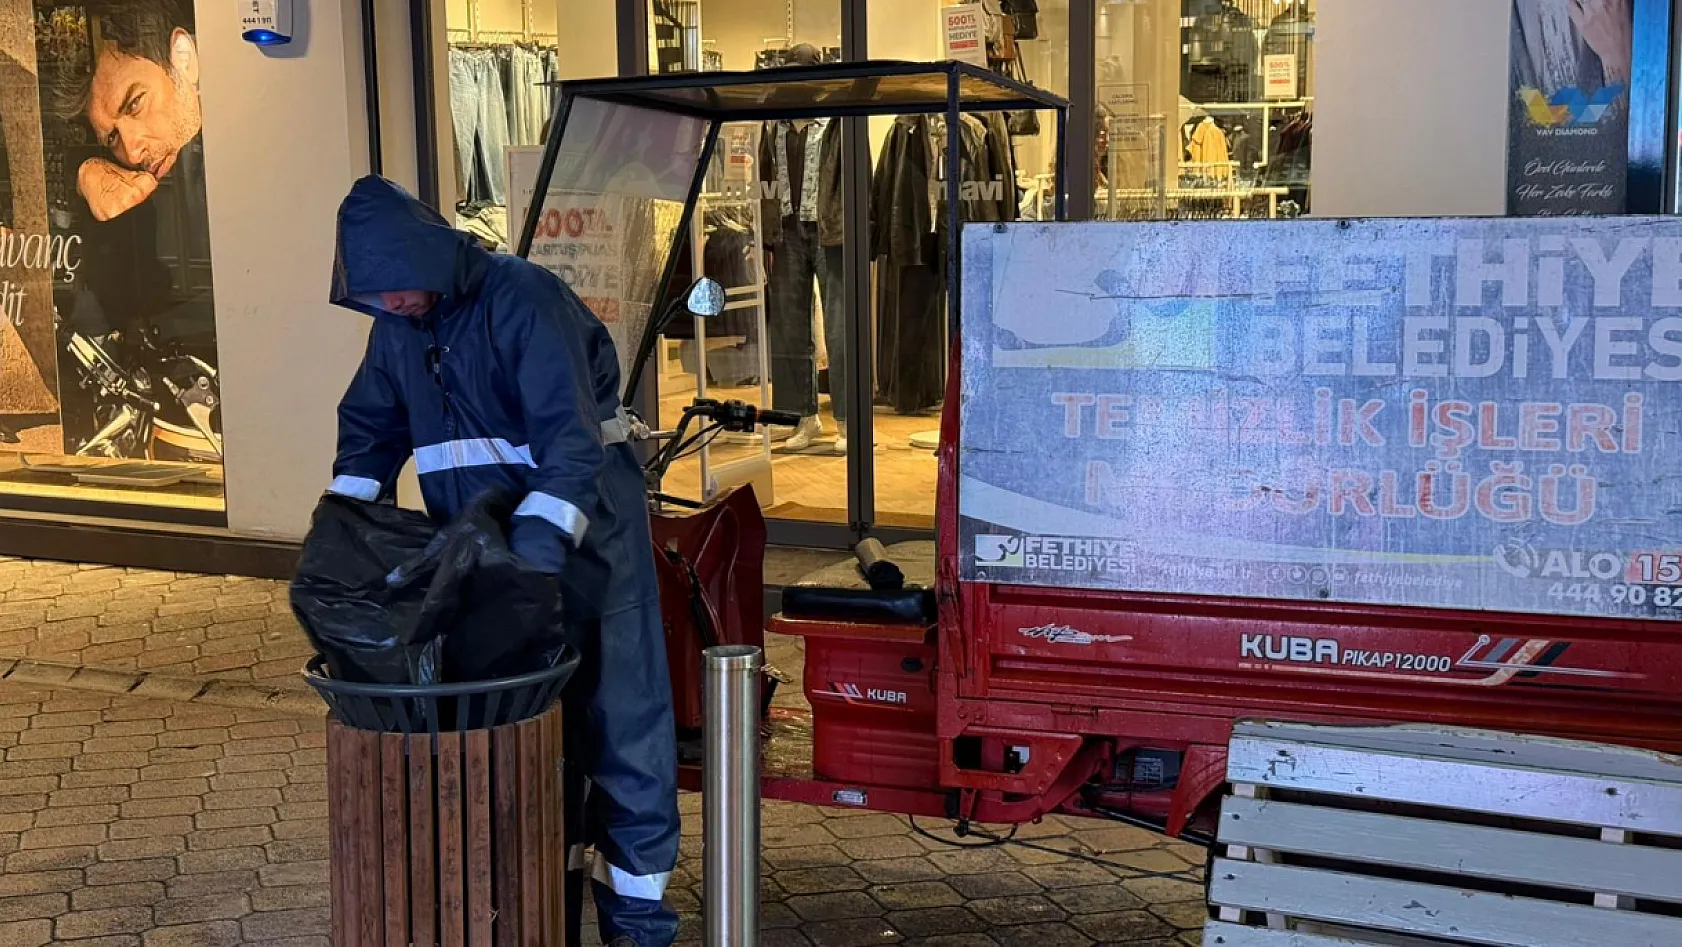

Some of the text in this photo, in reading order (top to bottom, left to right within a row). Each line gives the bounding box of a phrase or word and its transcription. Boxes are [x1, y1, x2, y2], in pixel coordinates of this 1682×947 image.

[1555, 128, 1598, 136] DIAMOND
[928, 173, 1004, 201] mavi
[1409, 387, 1644, 459] İŞLERİ
[1540, 550, 1622, 579] ALO
[1546, 581, 1601, 602] 444
[1609, 583, 1647, 606] 90
[1240, 633, 1339, 665] KUBA
[866, 683, 907, 703] KUBA
